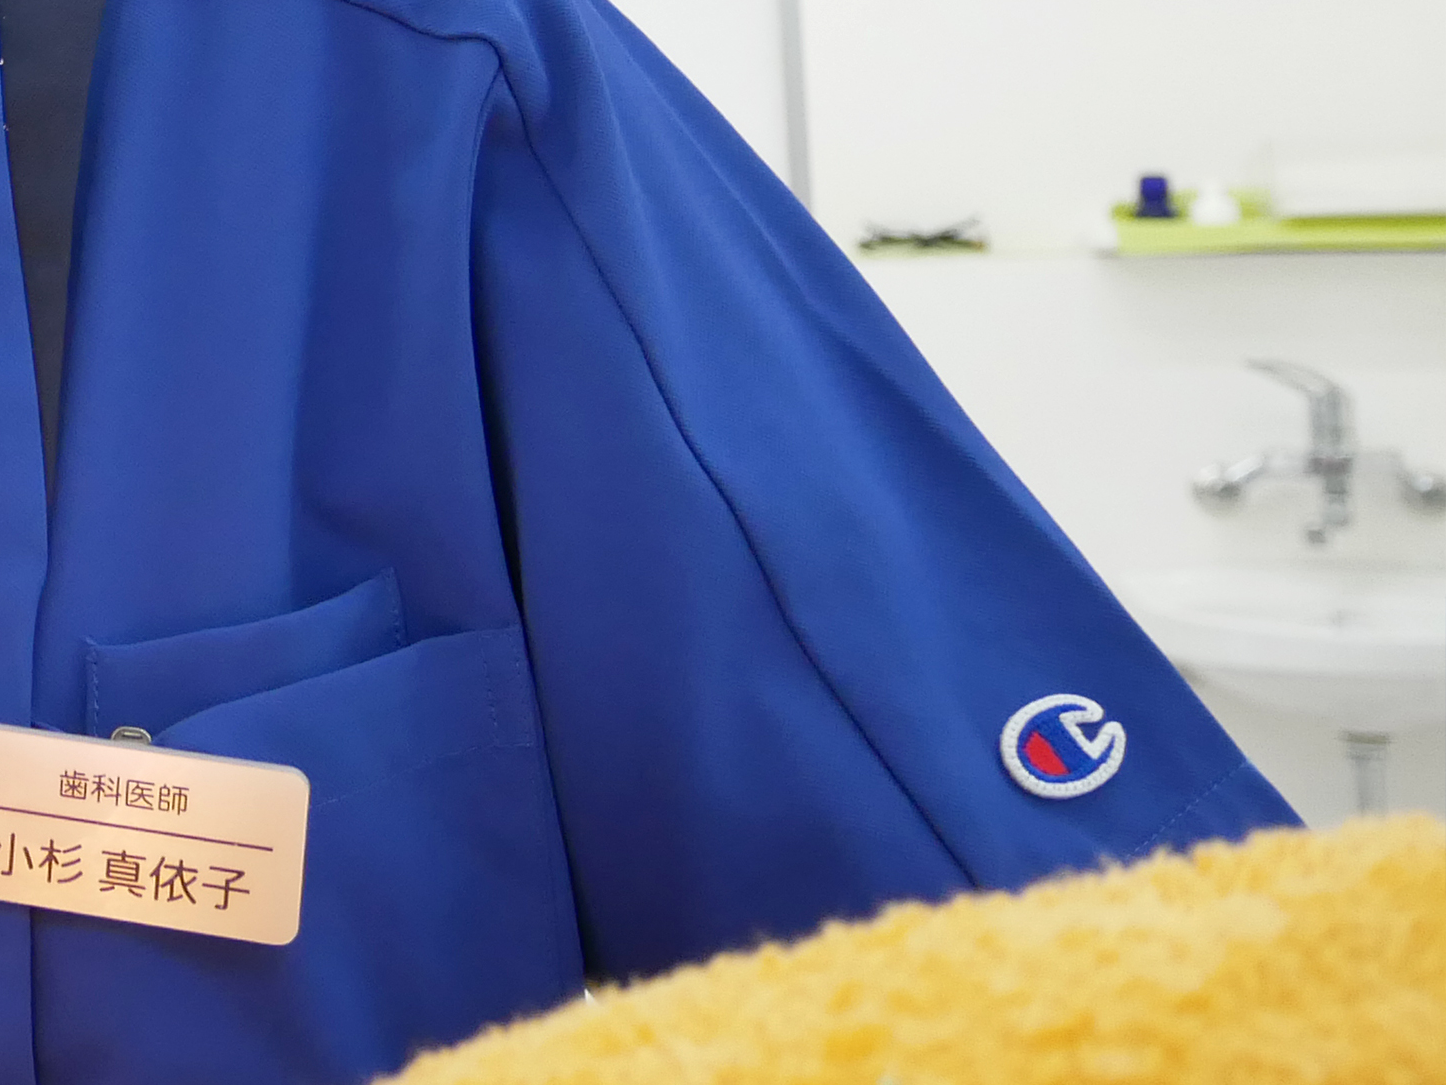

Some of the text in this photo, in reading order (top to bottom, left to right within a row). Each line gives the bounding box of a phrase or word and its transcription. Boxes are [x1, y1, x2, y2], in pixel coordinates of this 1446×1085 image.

[59, 769, 191, 816] 歯科医師
[98, 849, 251, 912] 真依子
